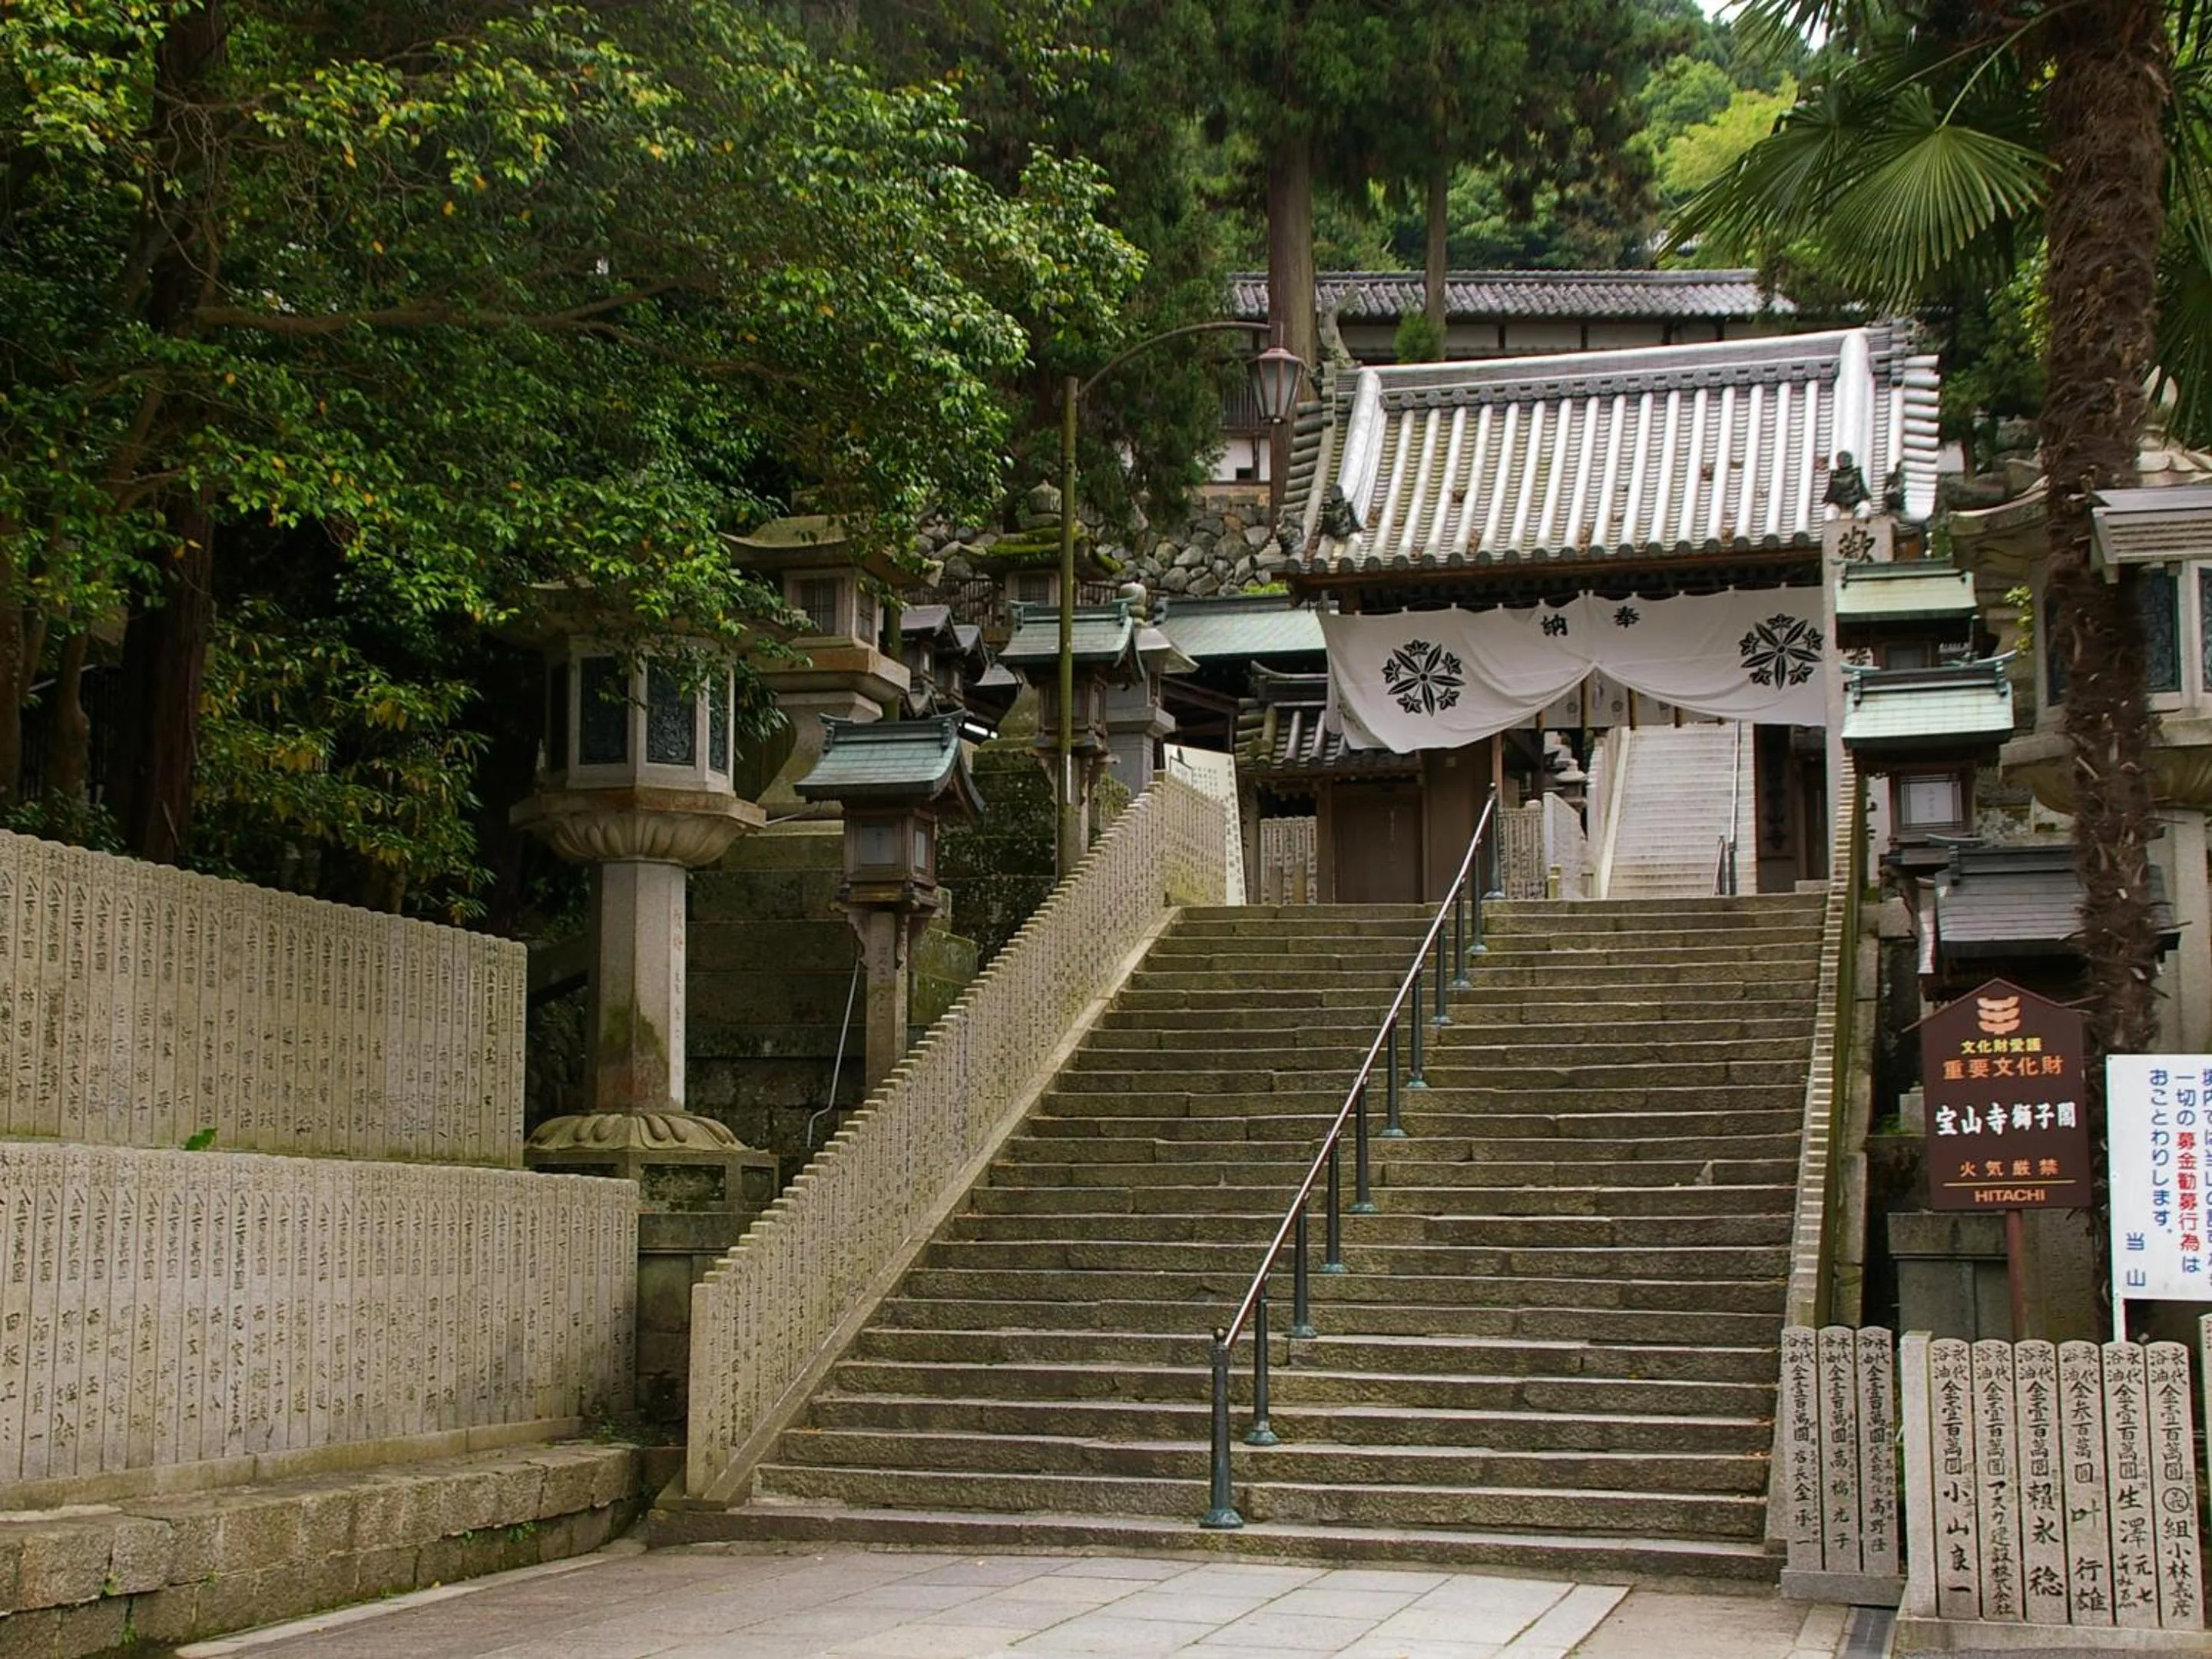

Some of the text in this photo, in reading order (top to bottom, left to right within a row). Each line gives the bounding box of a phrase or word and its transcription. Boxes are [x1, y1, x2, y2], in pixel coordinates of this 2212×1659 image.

[1961, 1038, 2041, 1054] 文化財愛護
[1943, 1055, 2064, 1080] 重要文化財
[1936, 1101, 2076, 1136] 宝山寺獅子閣
[1960, 1158, 2059, 1177] 火気厳禁
[1975, 1189, 2045, 1202] HITACHI
